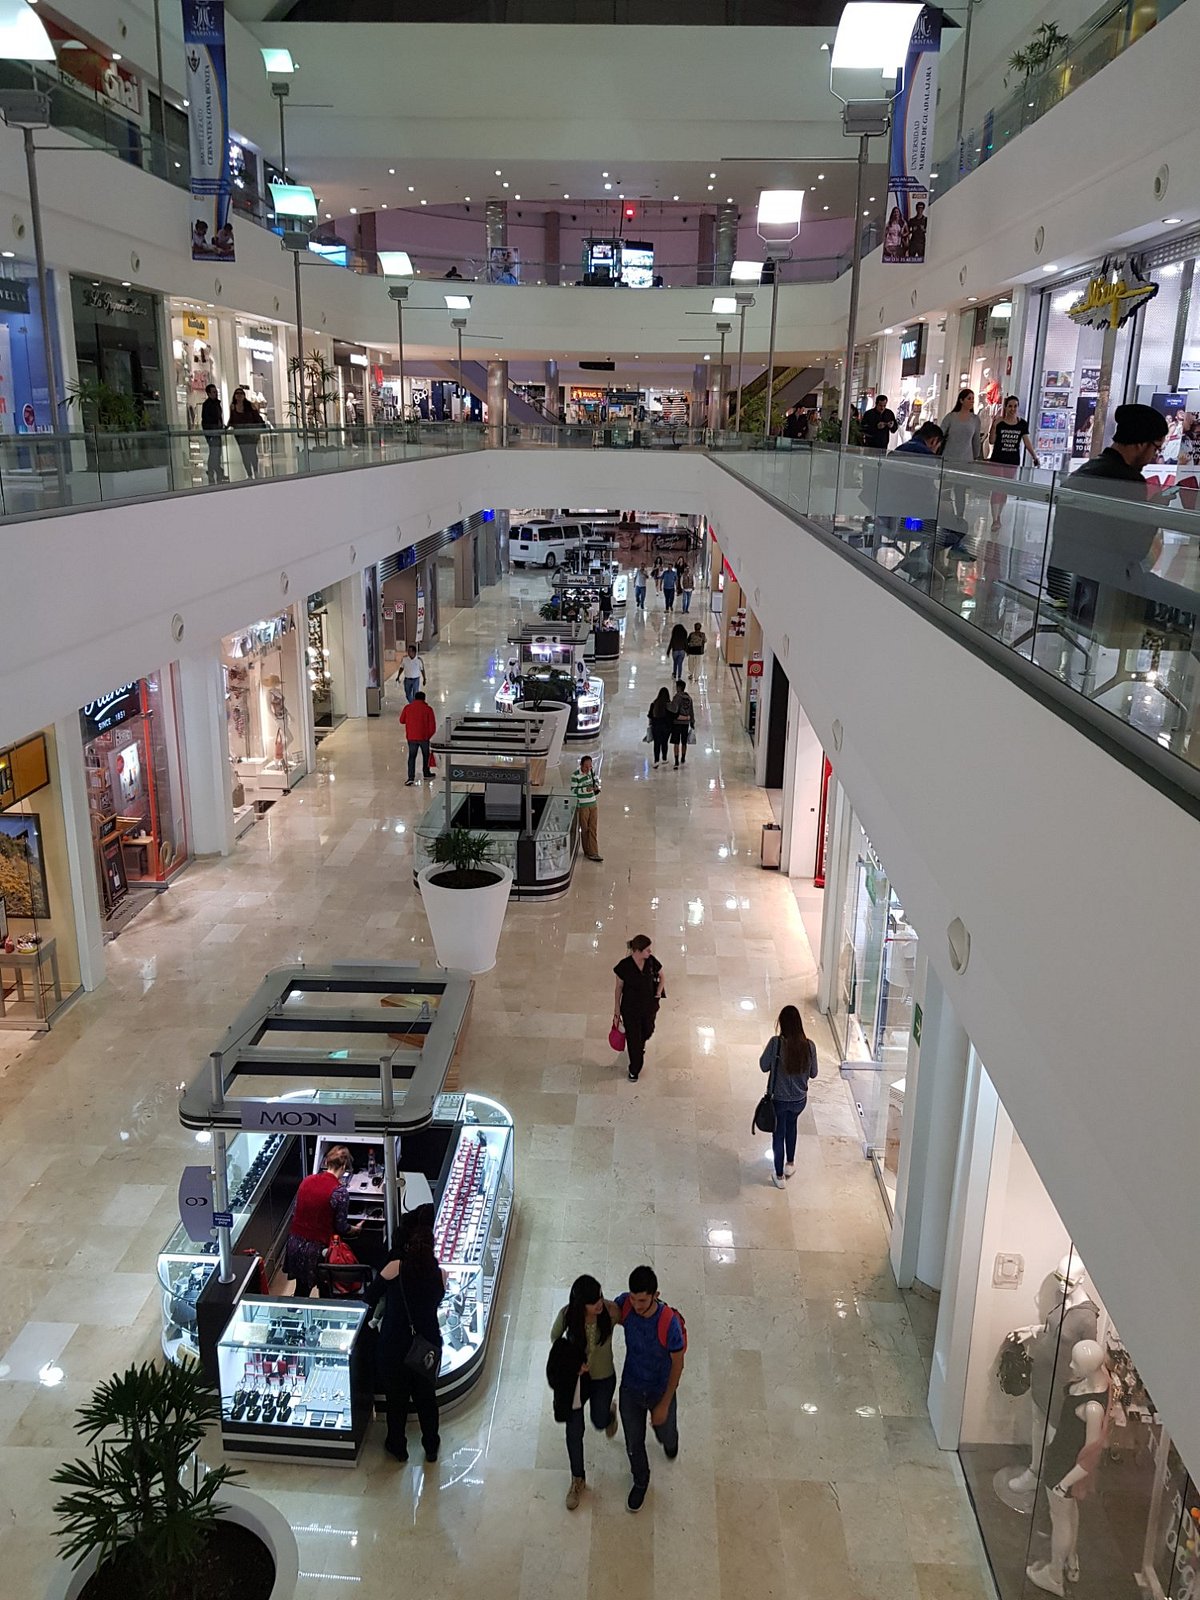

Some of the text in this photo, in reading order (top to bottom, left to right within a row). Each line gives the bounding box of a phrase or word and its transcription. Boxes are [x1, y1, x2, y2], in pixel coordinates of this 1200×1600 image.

[205, 95, 213, 119] LOMA
[918, 66, 932, 171] MARISTA DE GUADALAJARA
[206, 120, 214, 166] CERVANTES
[911, 120, 920, 171] UNIVERSIDAD
[98, 717, 112, 731] SINCE
[260, 1111, 337, 1127] MOON
